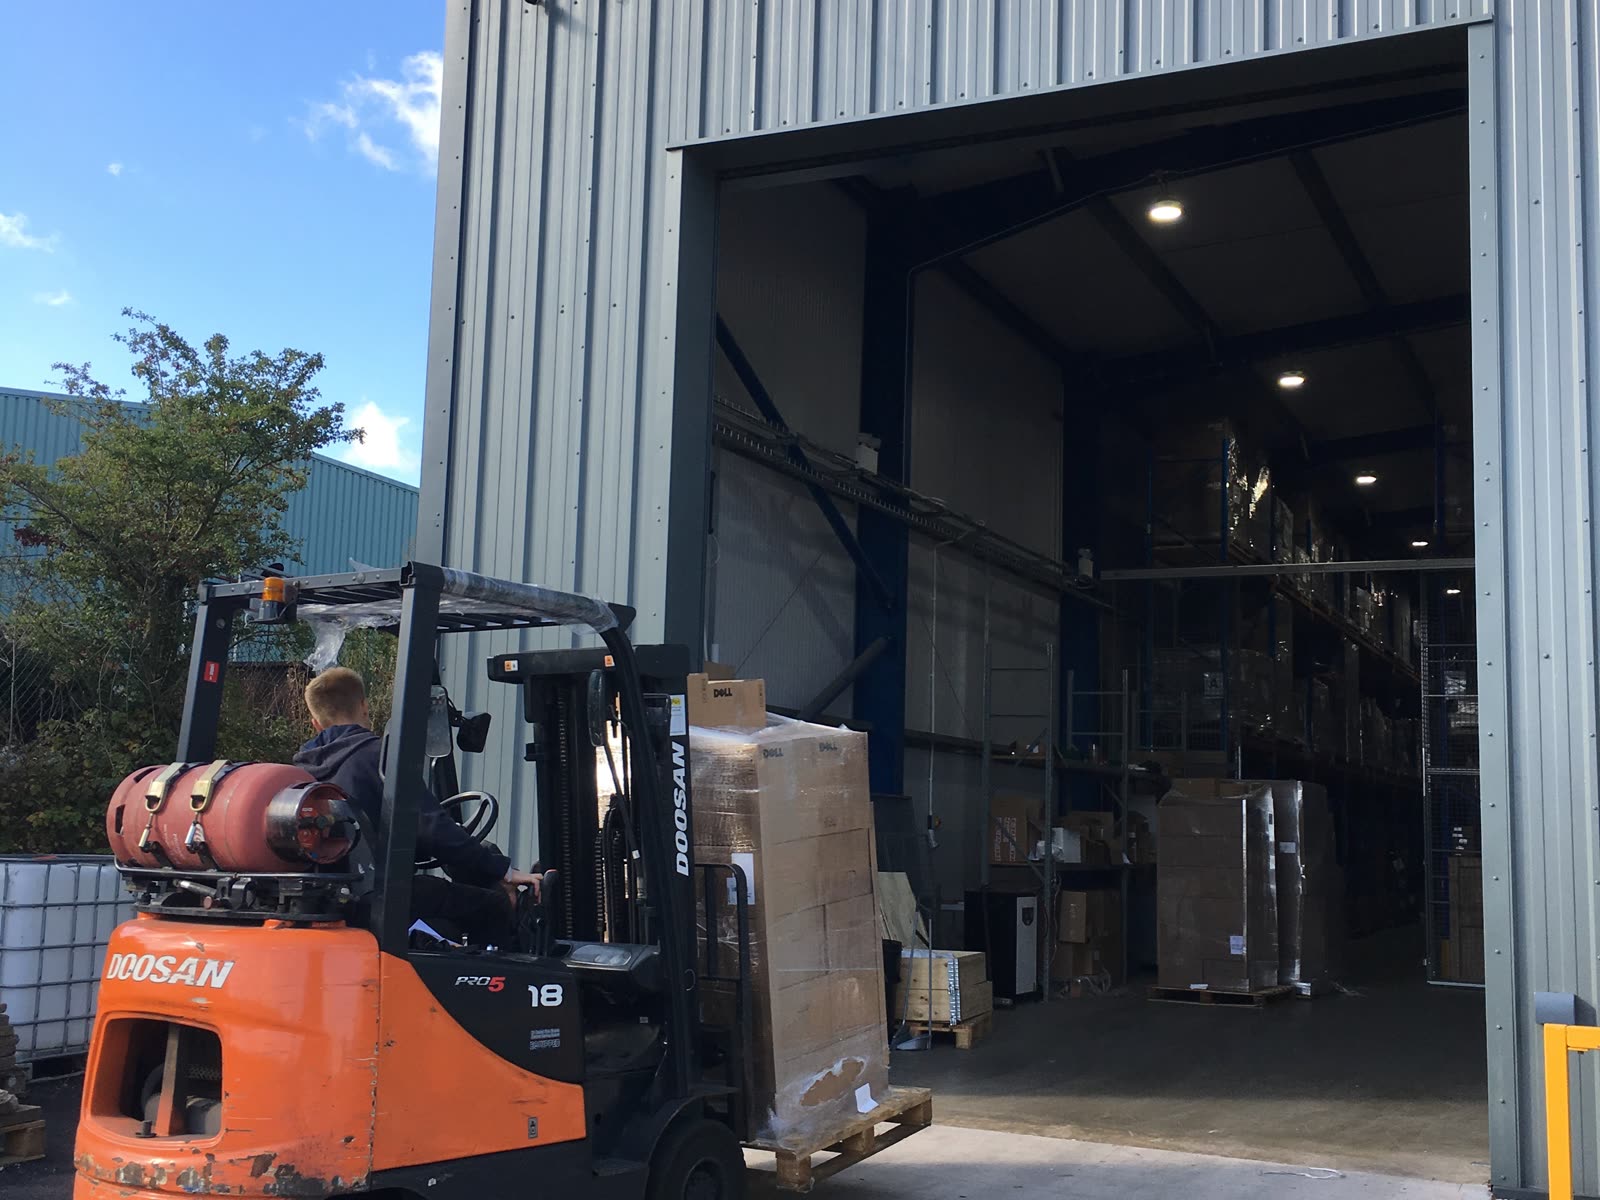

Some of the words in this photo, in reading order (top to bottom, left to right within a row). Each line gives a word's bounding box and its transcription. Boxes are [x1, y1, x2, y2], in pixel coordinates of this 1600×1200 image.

[713, 688, 733, 698] DELL
[762, 747, 784, 758] DELL
[671, 741, 690, 877] DOOSAN
[106, 953, 235, 989] DOOSAN
[528, 984, 563, 1008] 18
